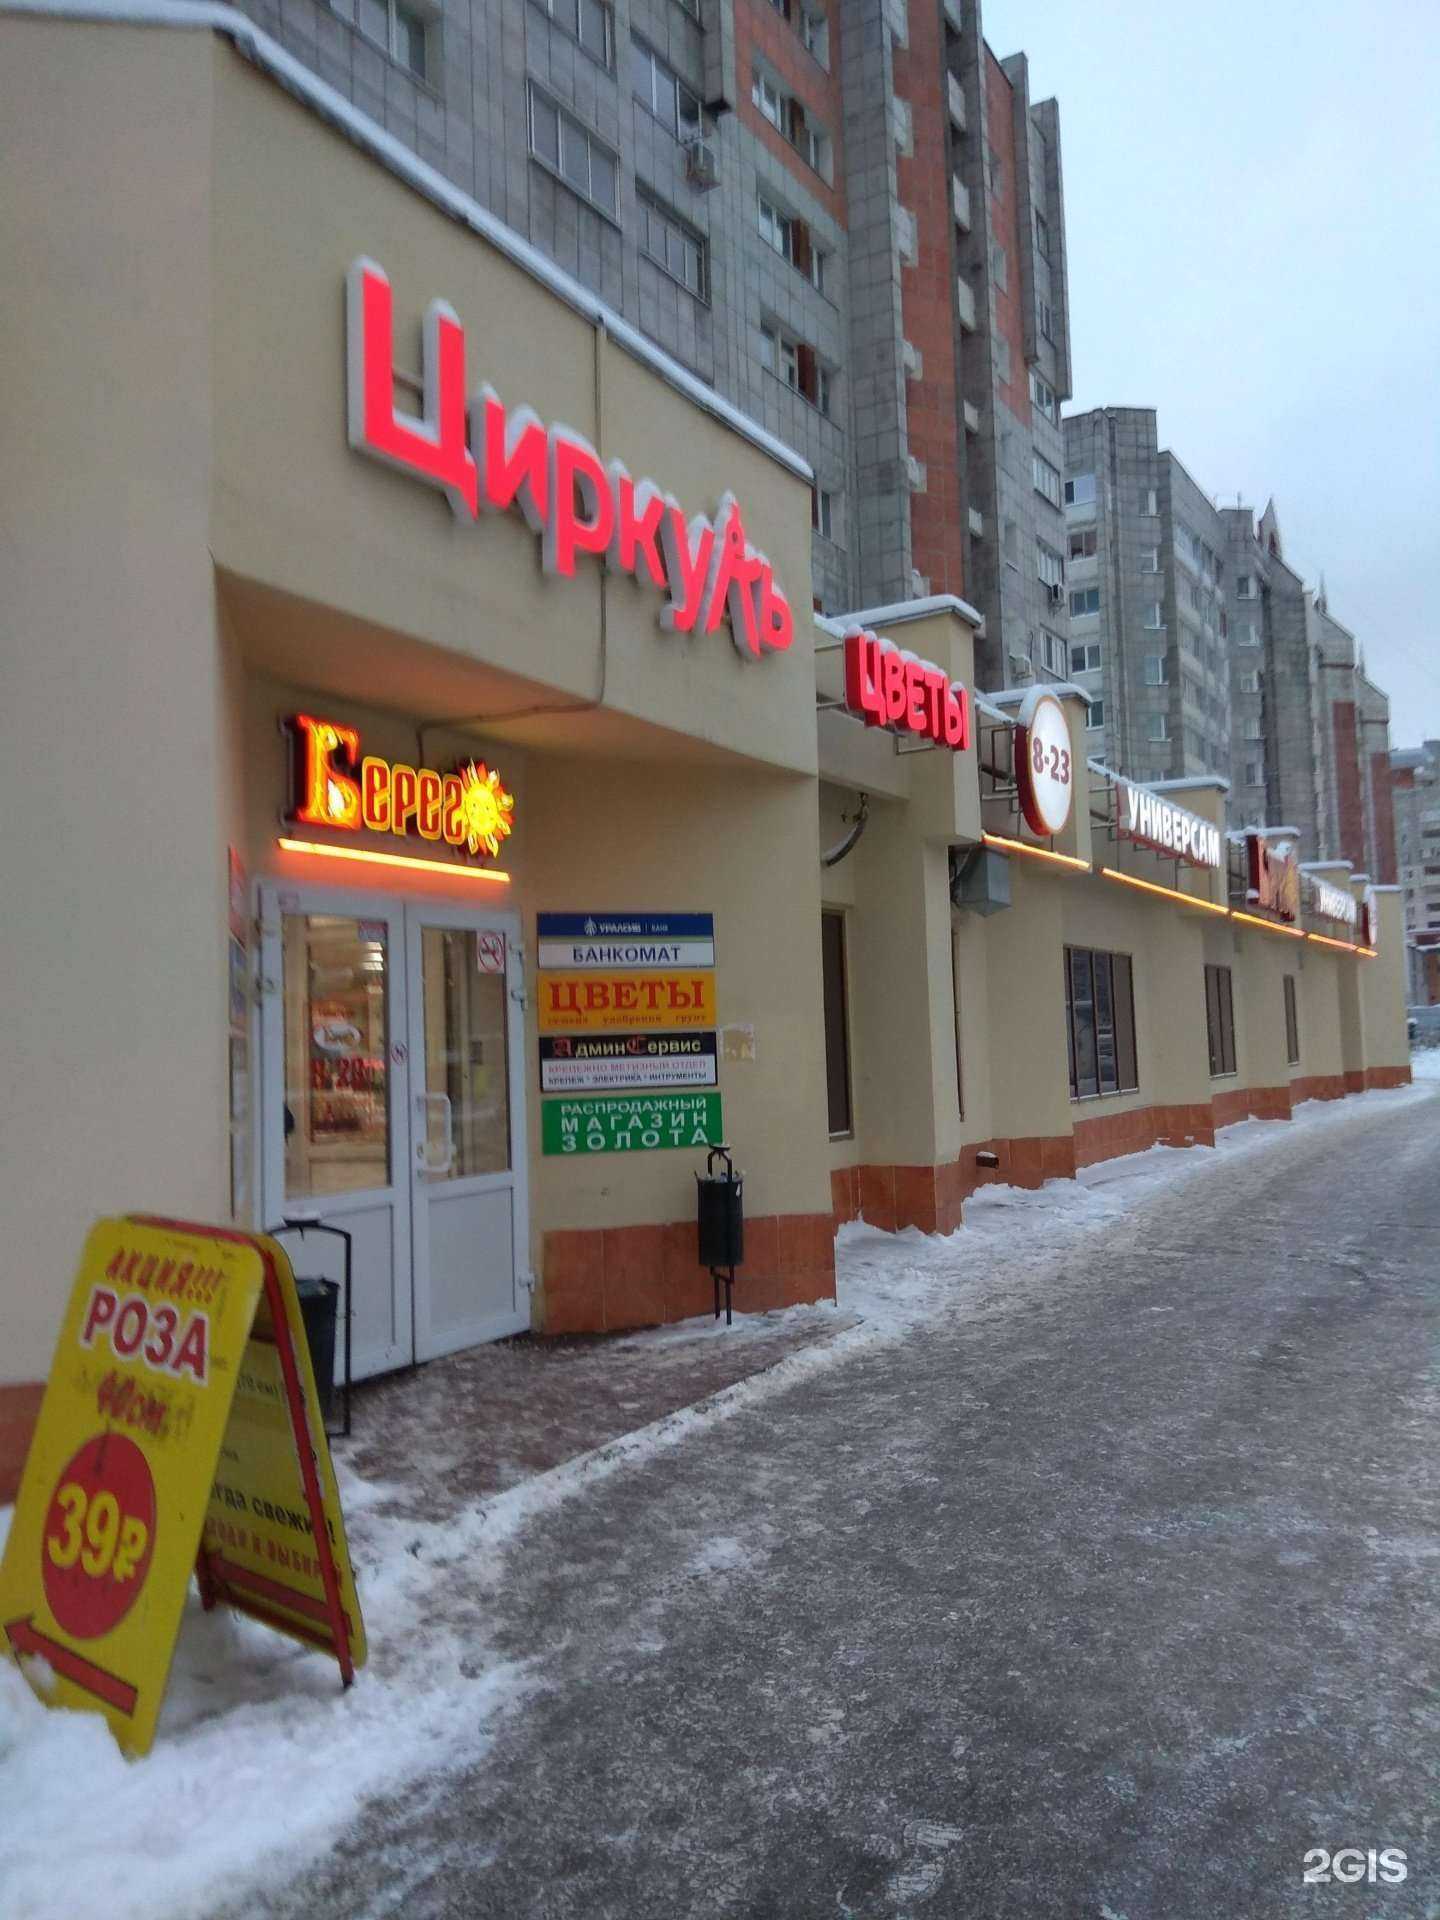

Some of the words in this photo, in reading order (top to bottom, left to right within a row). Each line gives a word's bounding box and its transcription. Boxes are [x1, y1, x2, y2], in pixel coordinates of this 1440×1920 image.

[349, 257, 794, 660] Циркуль
[845, 630, 969, 750] ЦВЕТЫ
[294, 713, 466, 846] Берег
[1032, 736, 1070, 785] 8-23
[1127, 786, 1220, 868] УНИВЕРСАМ
[572, 946, 681, 963] БАНКОМАТ
[549, 980, 705, 1015] ЦВЕТЫ
[561, 1097, 707, 1116] РАСПРОДАЖНЫЙ
[561, 1110, 708, 1134] МАГАЗИН
[562, 1127, 709, 1152] ЗОЛОТА
[82, 1286, 208, 1386] РОЗА
